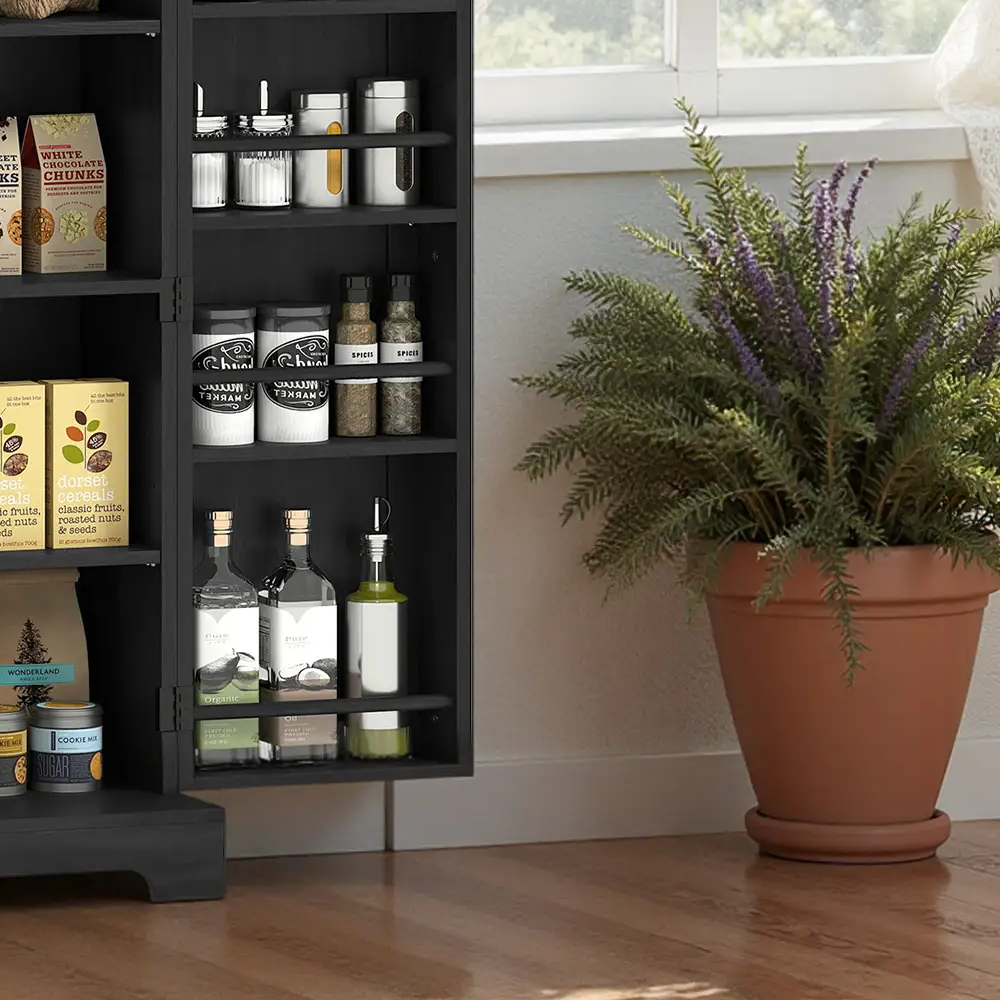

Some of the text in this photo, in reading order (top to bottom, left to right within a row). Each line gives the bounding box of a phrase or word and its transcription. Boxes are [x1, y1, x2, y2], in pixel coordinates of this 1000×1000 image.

[40, 150, 83, 160] WHITE
[43, 160, 103, 168] CHOCOLATE
[44, 169, 104, 180] CHUNKS
[57, 474, 109, 488] dorset
[58, 488, 114, 503] cereals
[10, 507, 41, 516] fruits,
[58, 503, 125, 514] classic fruits,
[14, 518, 37, 526] nuts
[58, 515, 95, 524] roasted
[58, 525, 97, 534] & seeds
[8, 668, 60, 676] WONDERLAND
[204, 696, 239, 704] Organic
[38, 754, 69, 778] SUGAR
